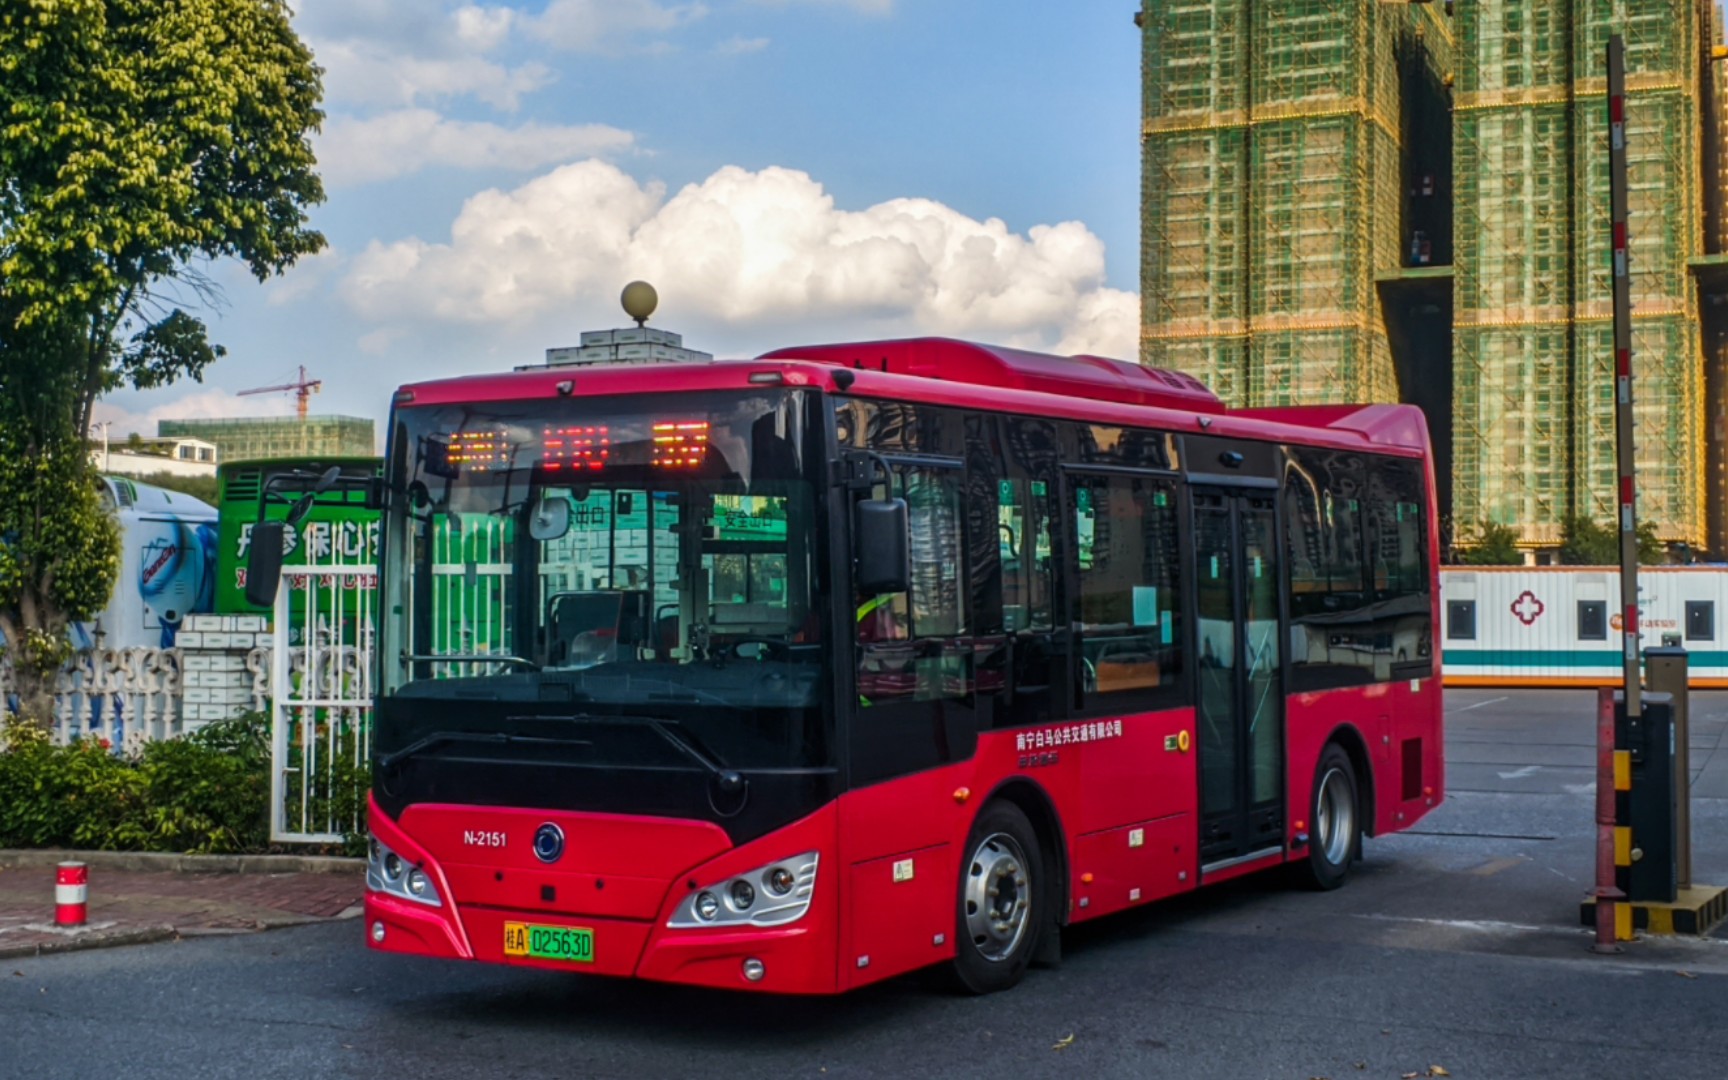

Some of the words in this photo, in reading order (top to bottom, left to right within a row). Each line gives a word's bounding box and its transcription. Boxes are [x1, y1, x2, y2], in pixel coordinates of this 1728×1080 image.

[1016, 719, 1122, 752] 南宁白马公共交通有限公司
[464, 830, 506, 847] N-2151
